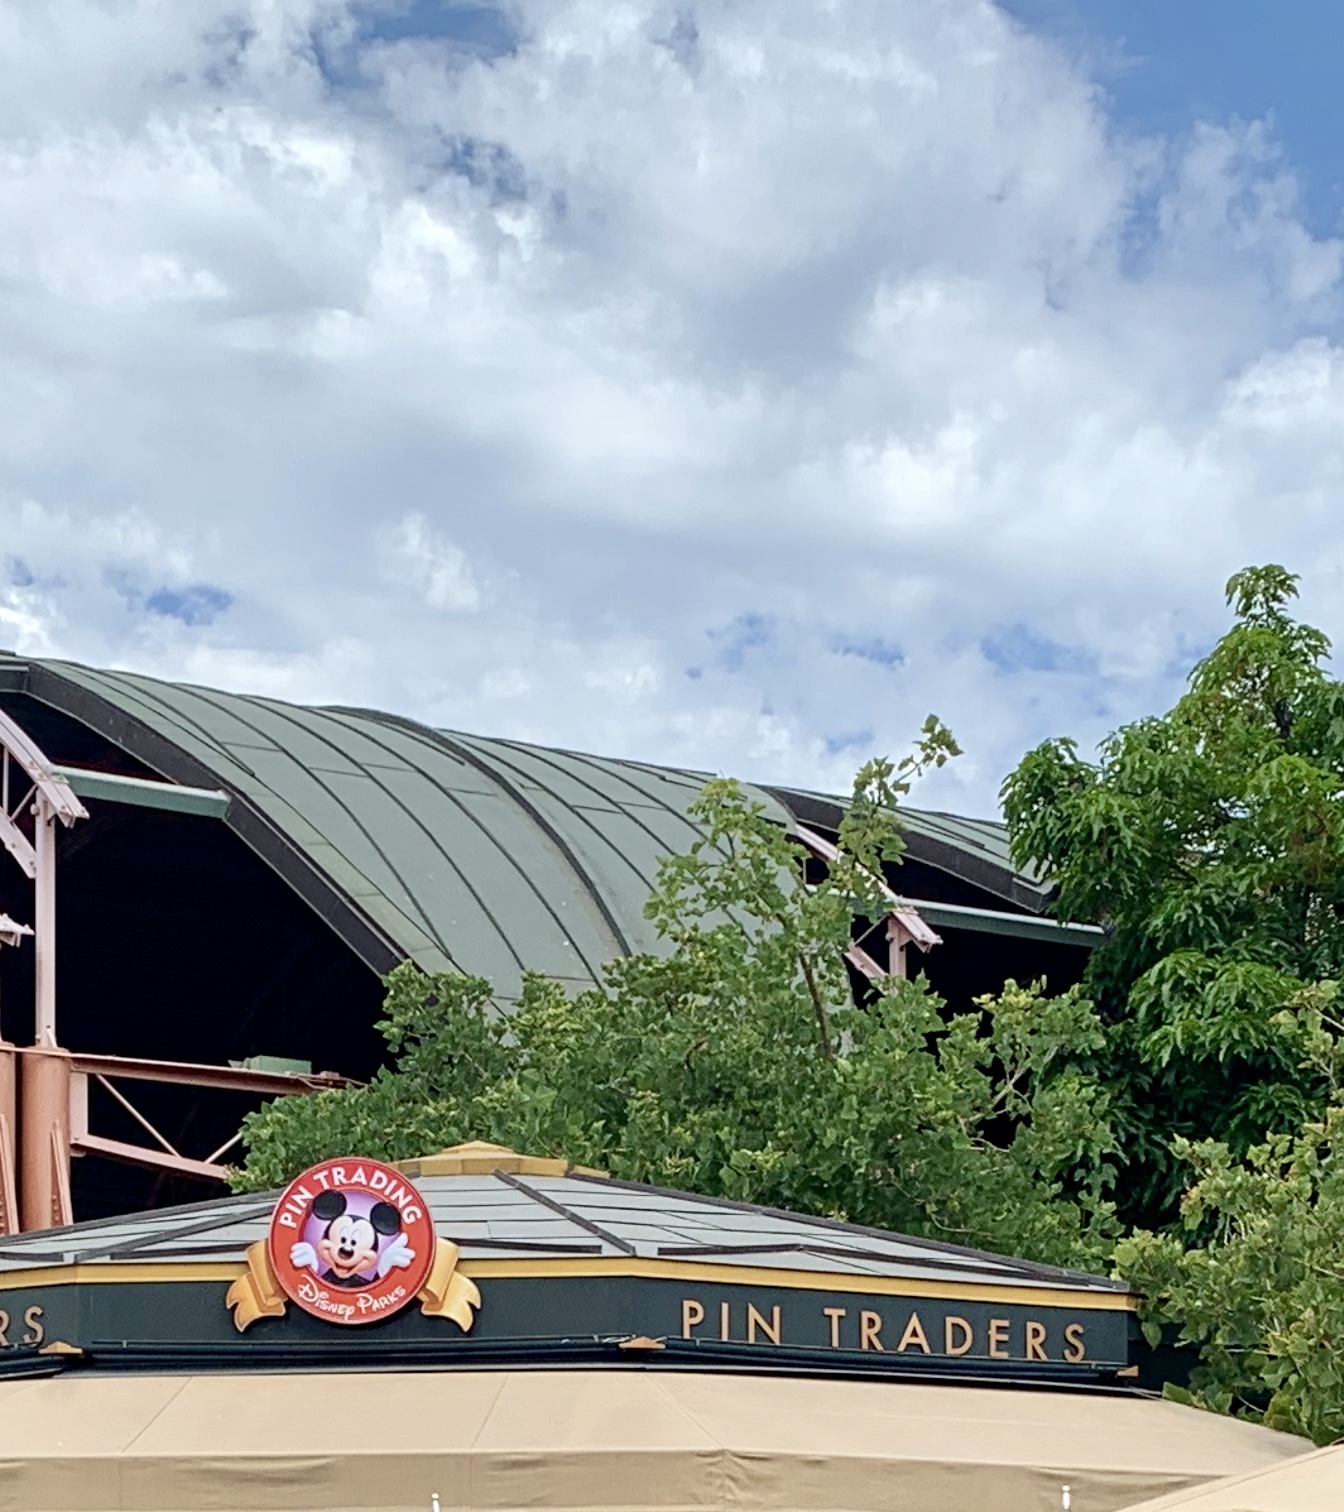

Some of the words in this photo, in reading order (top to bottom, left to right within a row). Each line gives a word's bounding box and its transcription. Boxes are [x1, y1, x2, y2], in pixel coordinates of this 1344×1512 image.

[279, 1185, 314, 1228] PIN
[313, 1166, 422, 1224] TRADING
[681, 1300, 781, 1345] PIN
[823, 1307, 1086, 1363] TRADERS
